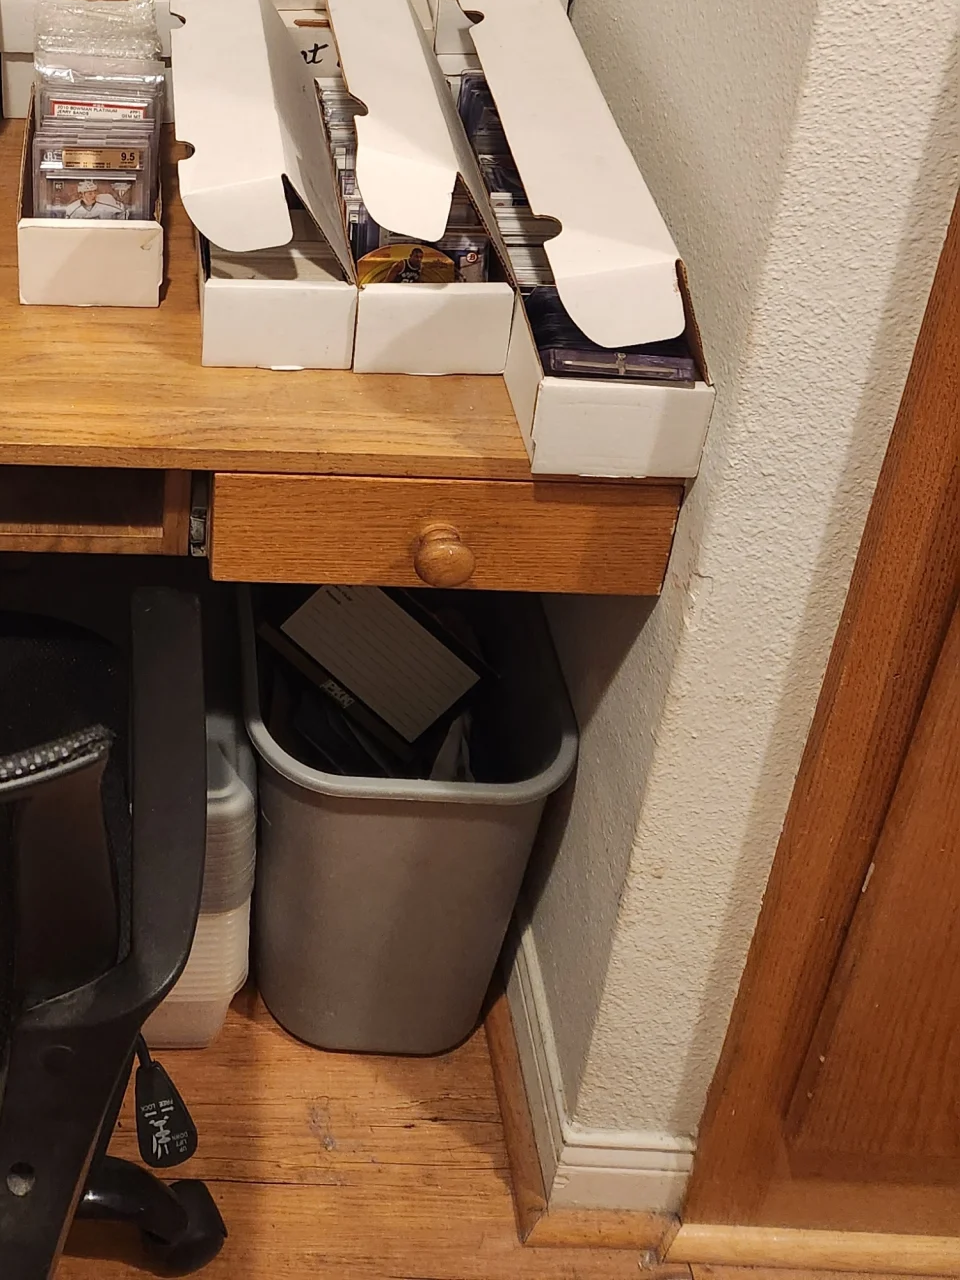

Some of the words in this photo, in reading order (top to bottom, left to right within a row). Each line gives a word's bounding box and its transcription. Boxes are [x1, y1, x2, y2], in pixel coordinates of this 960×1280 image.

[120, 152, 135, 162] 9.5
[140, 1102, 156, 1112] LOCK
[171, 1131, 189, 1140] DOWN
[175, 1138, 188, 1147] LIFT
